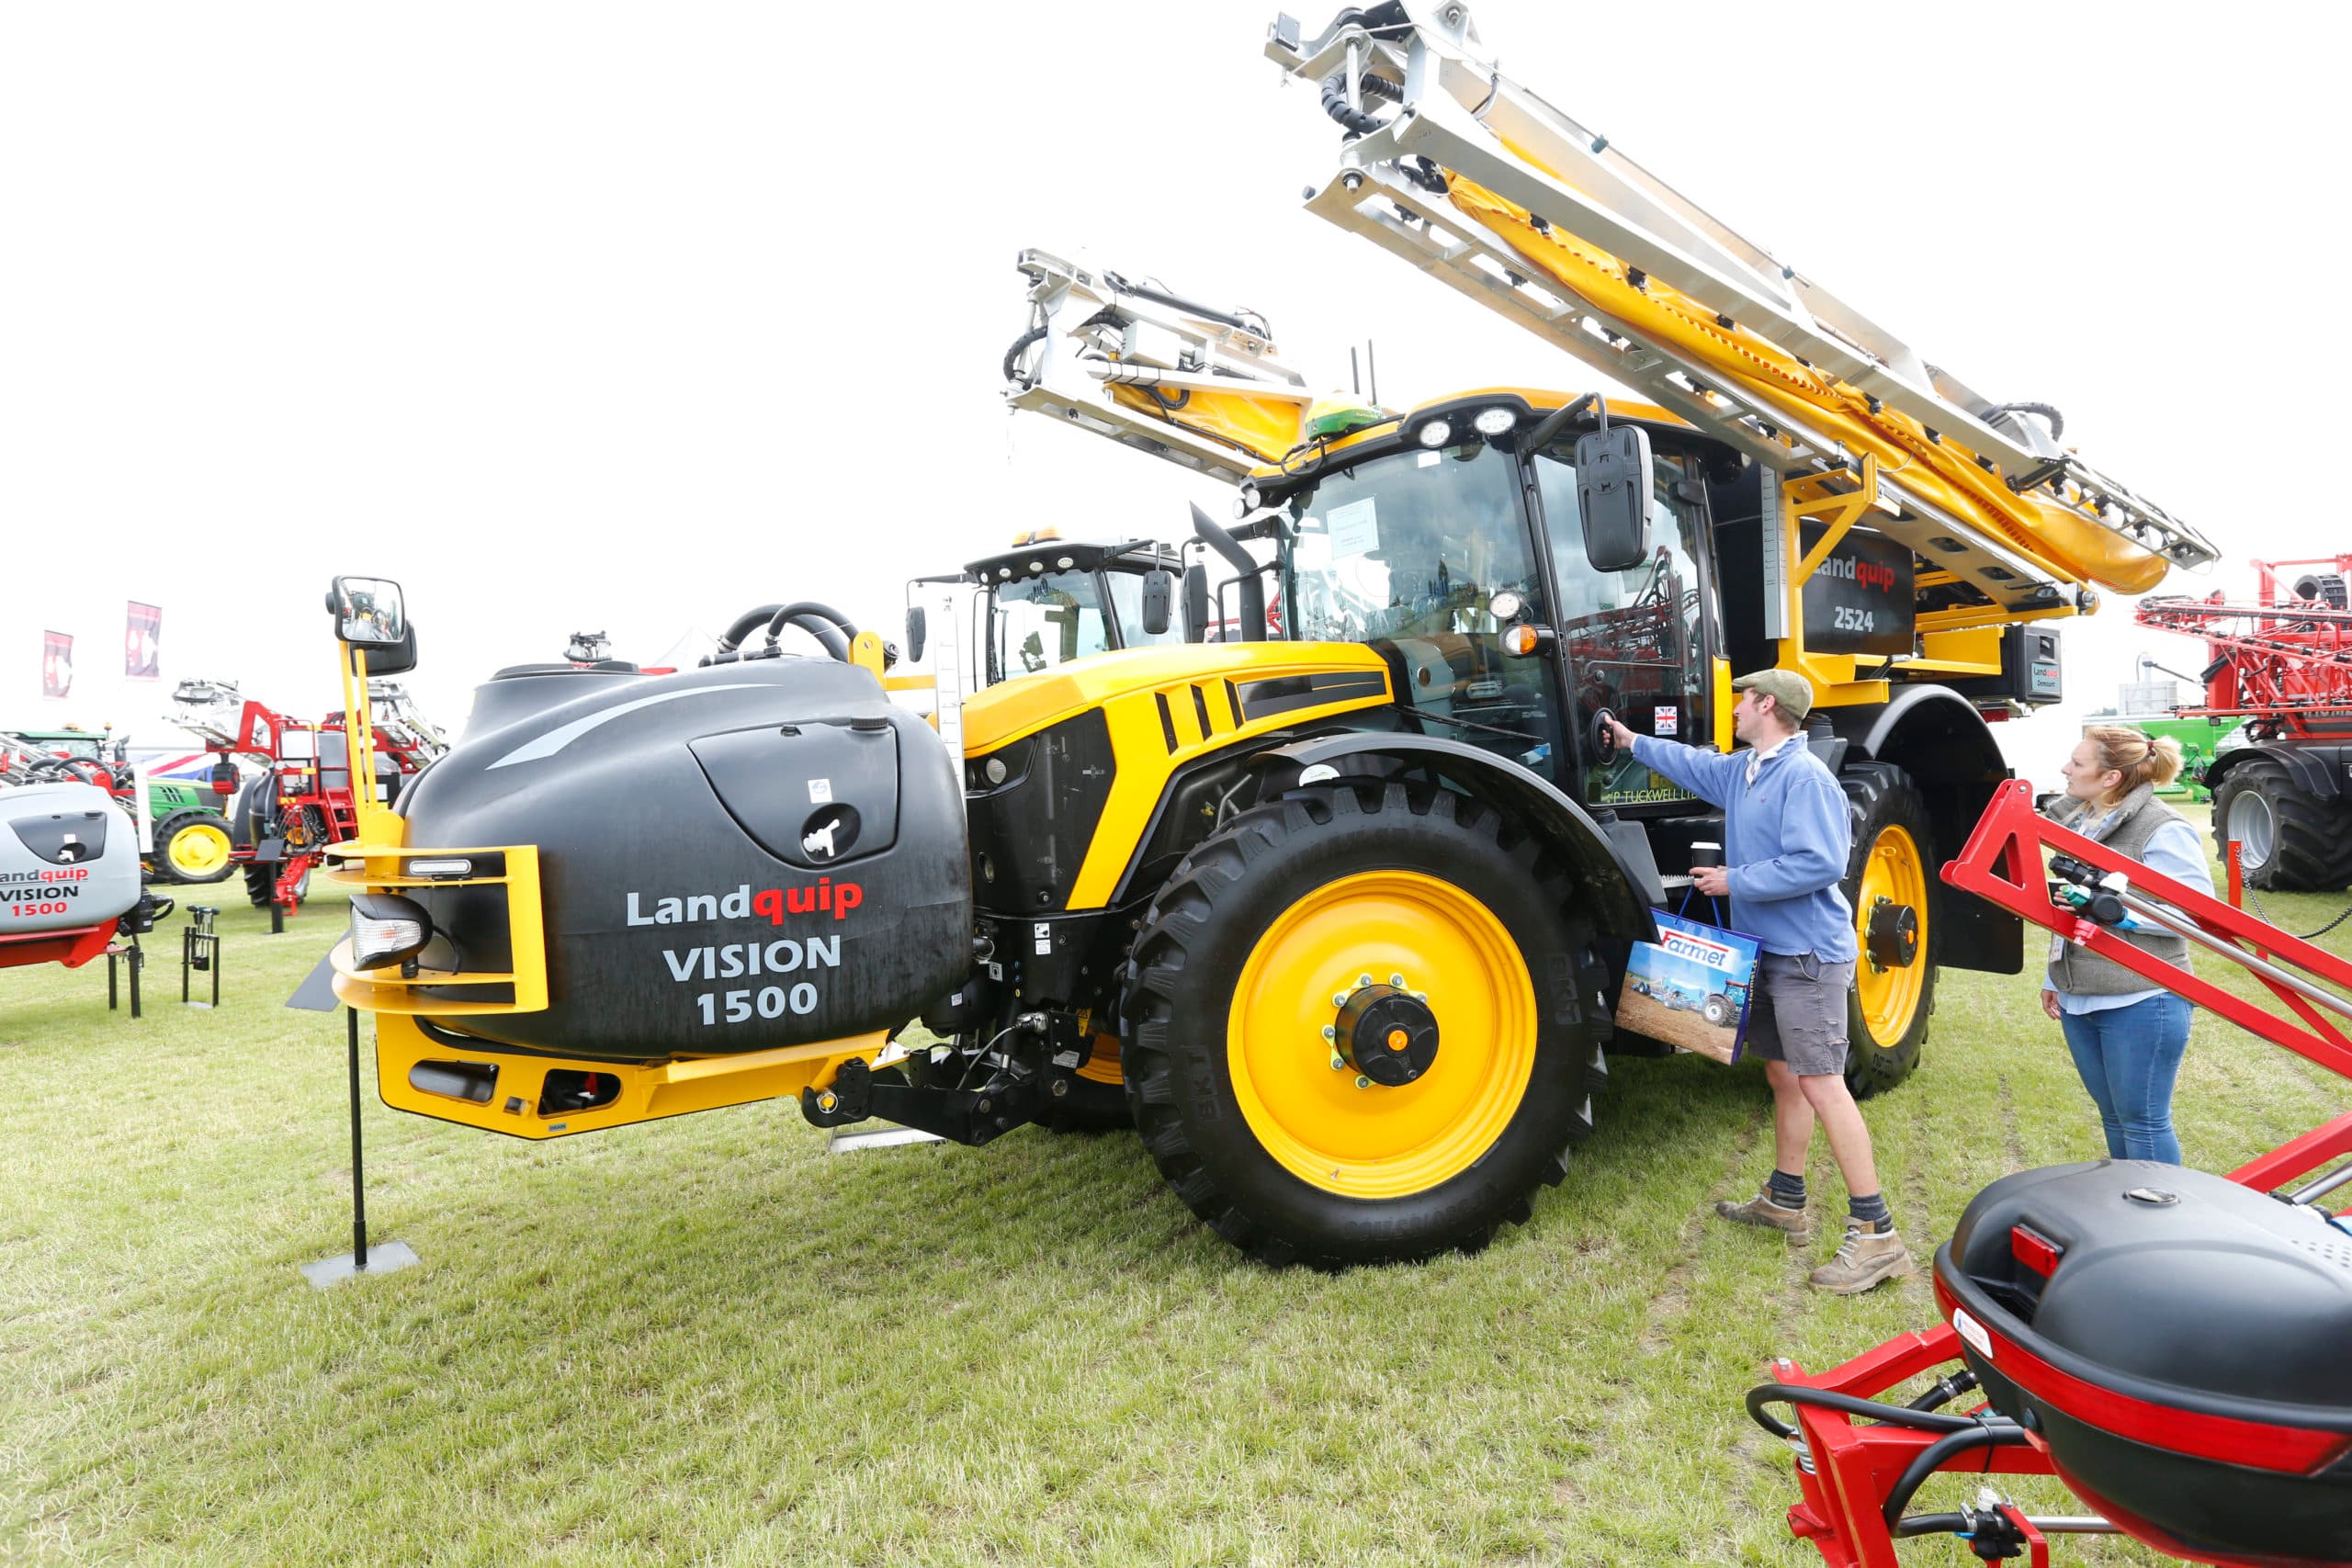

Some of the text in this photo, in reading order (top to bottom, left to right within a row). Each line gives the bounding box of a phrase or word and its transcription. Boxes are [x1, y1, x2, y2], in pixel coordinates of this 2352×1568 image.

[1814, 556, 1895, 593] andquip
[1834, 605, 1874, 633] 2524
[1623, 788, 1678, 802] TUCKWELL
[0, 867, 88, 882] andquip
[0, 886, 79, 902] VISION
[12, 901, 68, 917] 1500
[627, 877, 864, 927] Landquip
[662, 934, 841, 982] VISION
[1661, 931, 1729, 966] Farmet
[696, 982, 819, 1026] 1500
